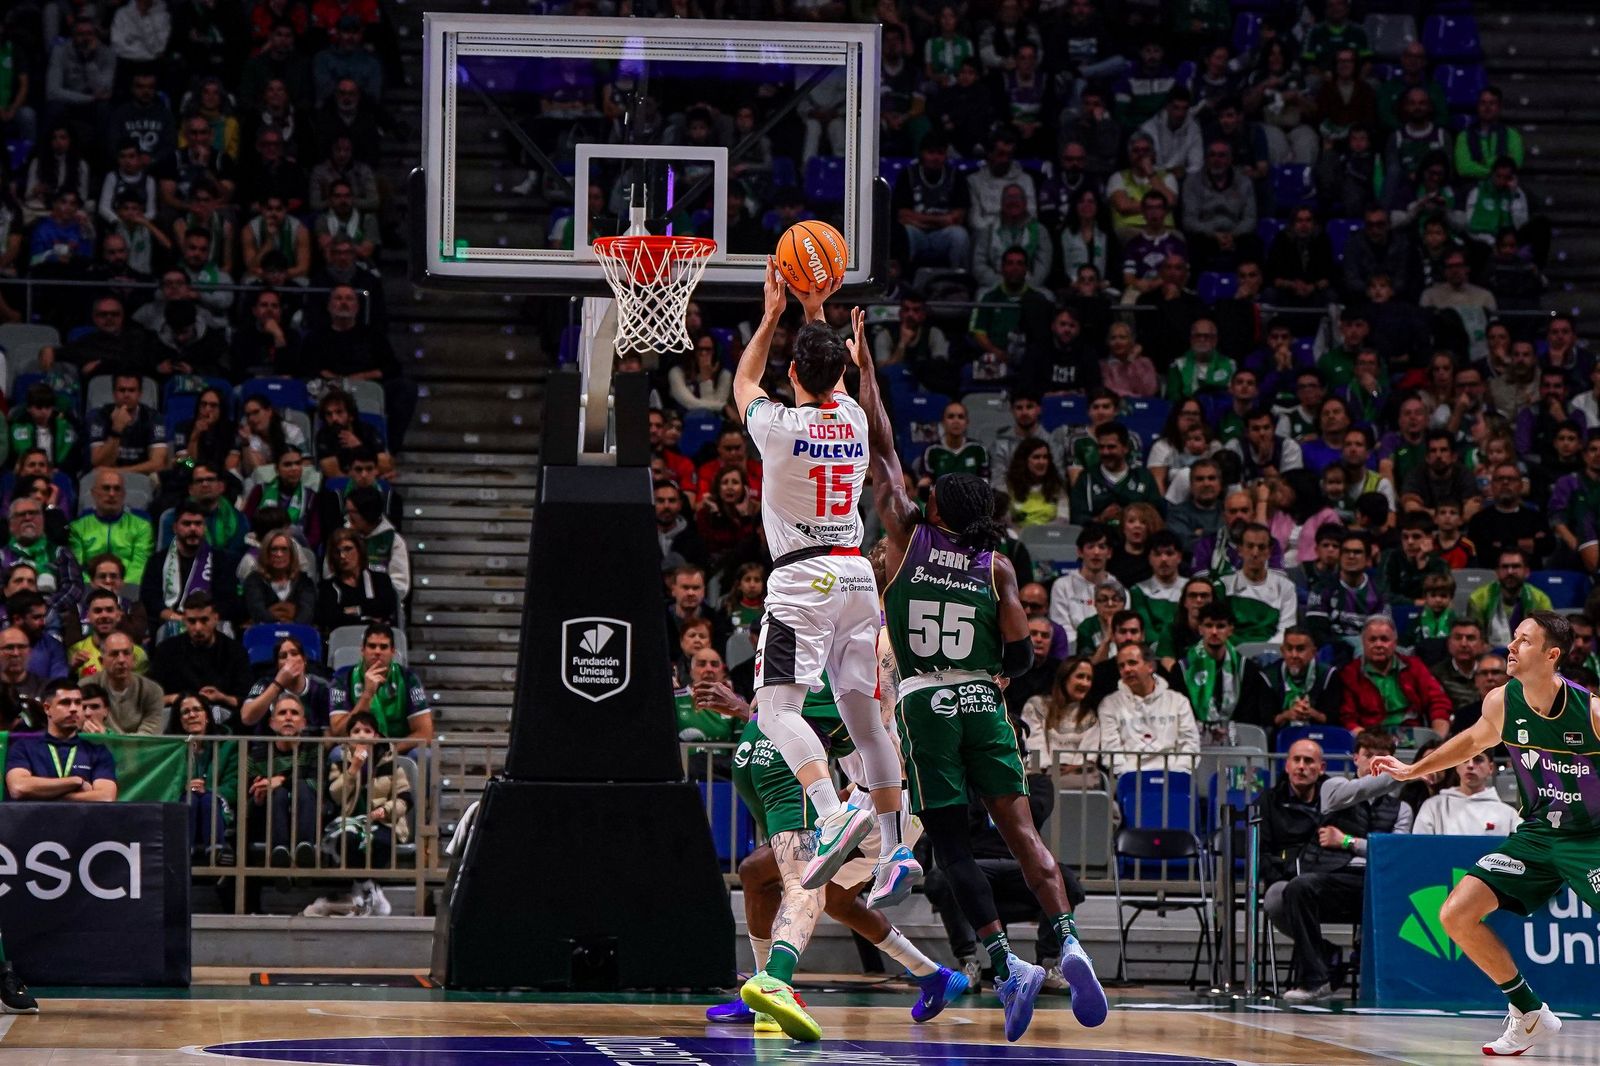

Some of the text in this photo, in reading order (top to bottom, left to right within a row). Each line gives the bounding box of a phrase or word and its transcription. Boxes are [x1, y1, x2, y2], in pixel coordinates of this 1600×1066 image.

[802, 236, 828, 284] Wilson
[787, 264, 799, 282] acb
[808, 423, 854, 440] COSTA
[793, 439, 863, 458] PULEVA
[808, 464, 855, 517] 15
[929, 548, 971, 571] PERRY
[839, 575, 872, 585] Diputación
[848, 584, 874, 592] Granada
[908, 599, 976, 660] 55
[572, 656, 619, 666] Fundación
[579, 667, 613, 677] Unicaja
[572, 676, 619, 684] Baloncesto
[958, 684, 995, 696] COSTA
[960, 694, 995, 706] DEL SOL
[960, 703, 997, 714] MÁLAGA
[759, 749, 774, 760] SOL
[1541, 759, 1591, 779] Unicaja
